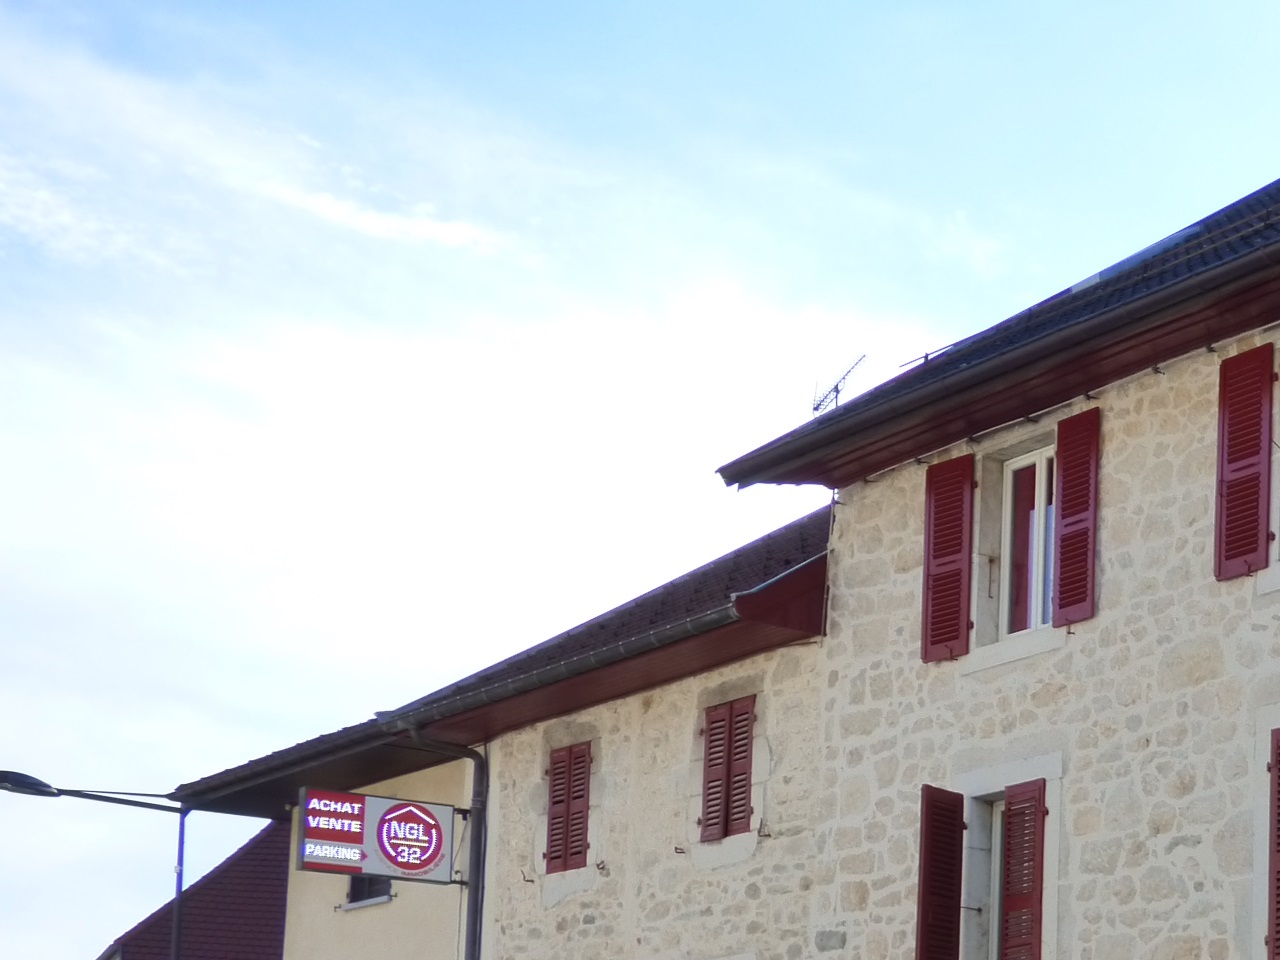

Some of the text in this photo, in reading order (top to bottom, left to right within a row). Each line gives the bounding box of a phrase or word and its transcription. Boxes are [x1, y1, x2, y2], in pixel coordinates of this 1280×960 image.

[308, 799, 362, 815] ACHAT
[307, 815, 361, 832] VENTE
[391, 821, 429, 840] NGL
[305, 844, 361, 860] PARKING
[397, 847, 421, 864] 32
